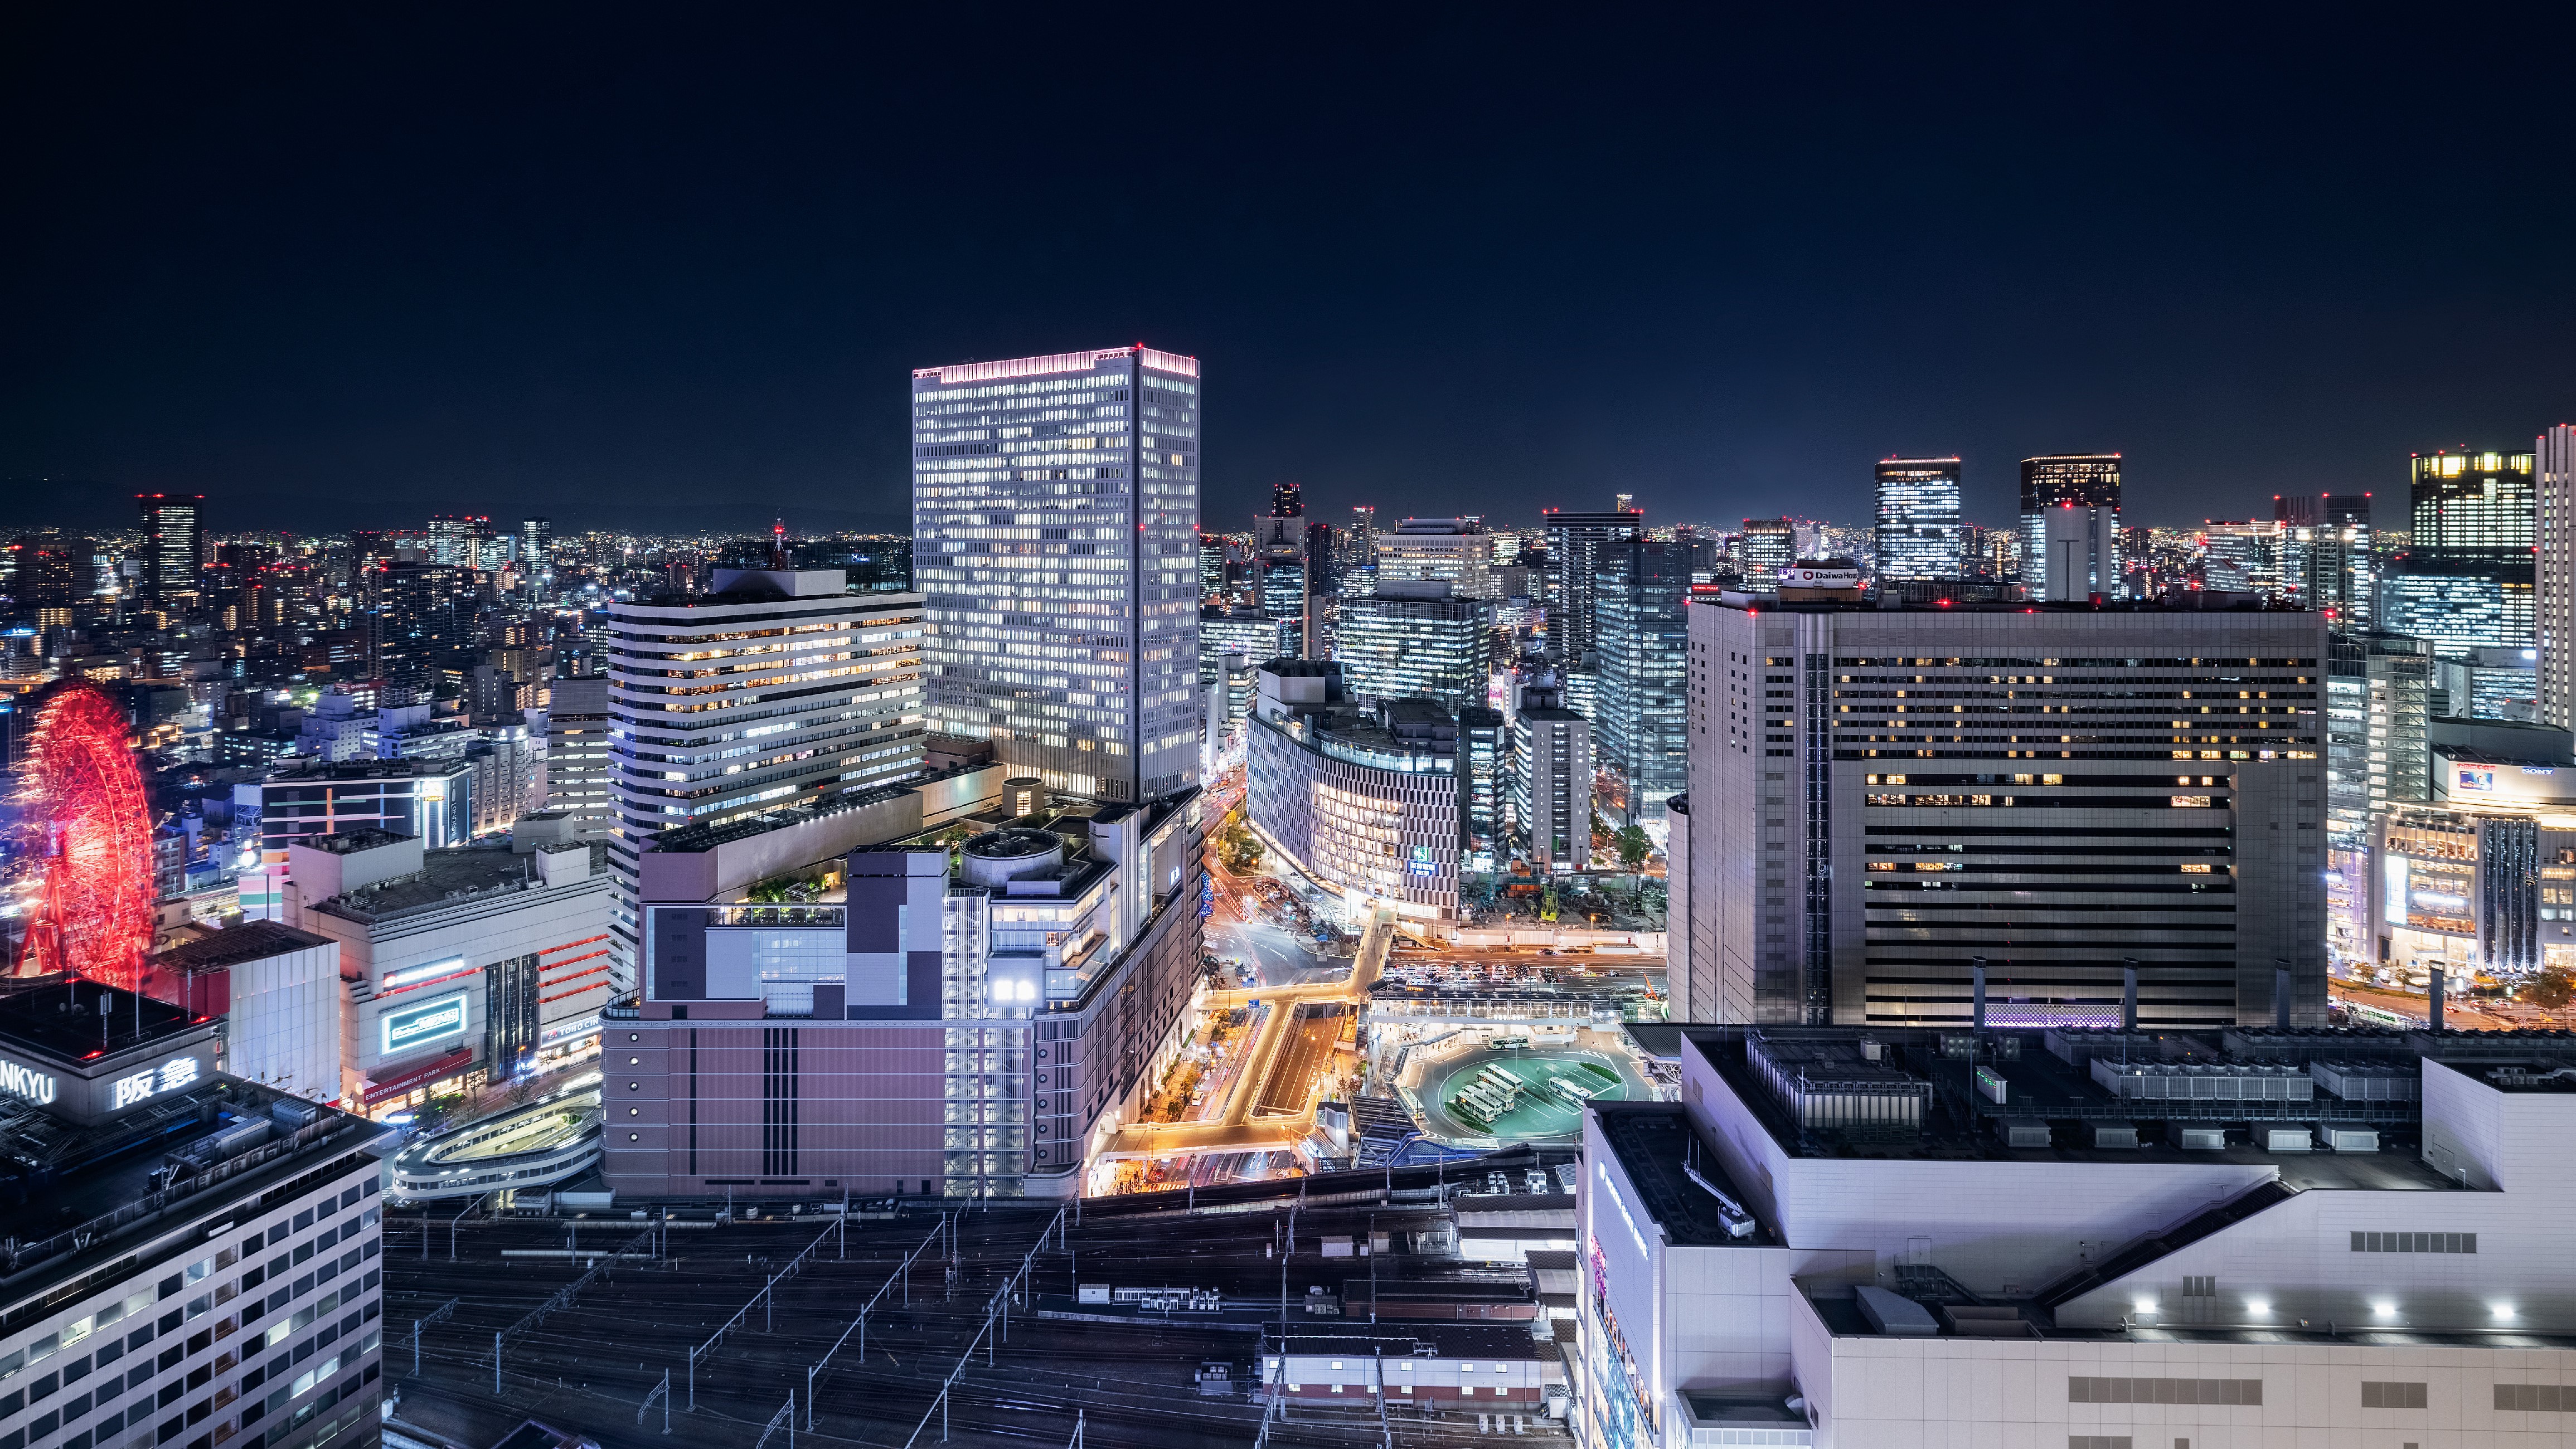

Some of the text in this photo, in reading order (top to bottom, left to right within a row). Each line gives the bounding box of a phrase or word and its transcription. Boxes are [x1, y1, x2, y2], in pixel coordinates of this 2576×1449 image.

[559, 1018, 600, 1036] TOHO CIN
[115, 1057, 197, 1111] 阪急
[365, 1074, 422, 1101] ENTERTAINMENT
[424, 1067, 441, 1079] PARK
